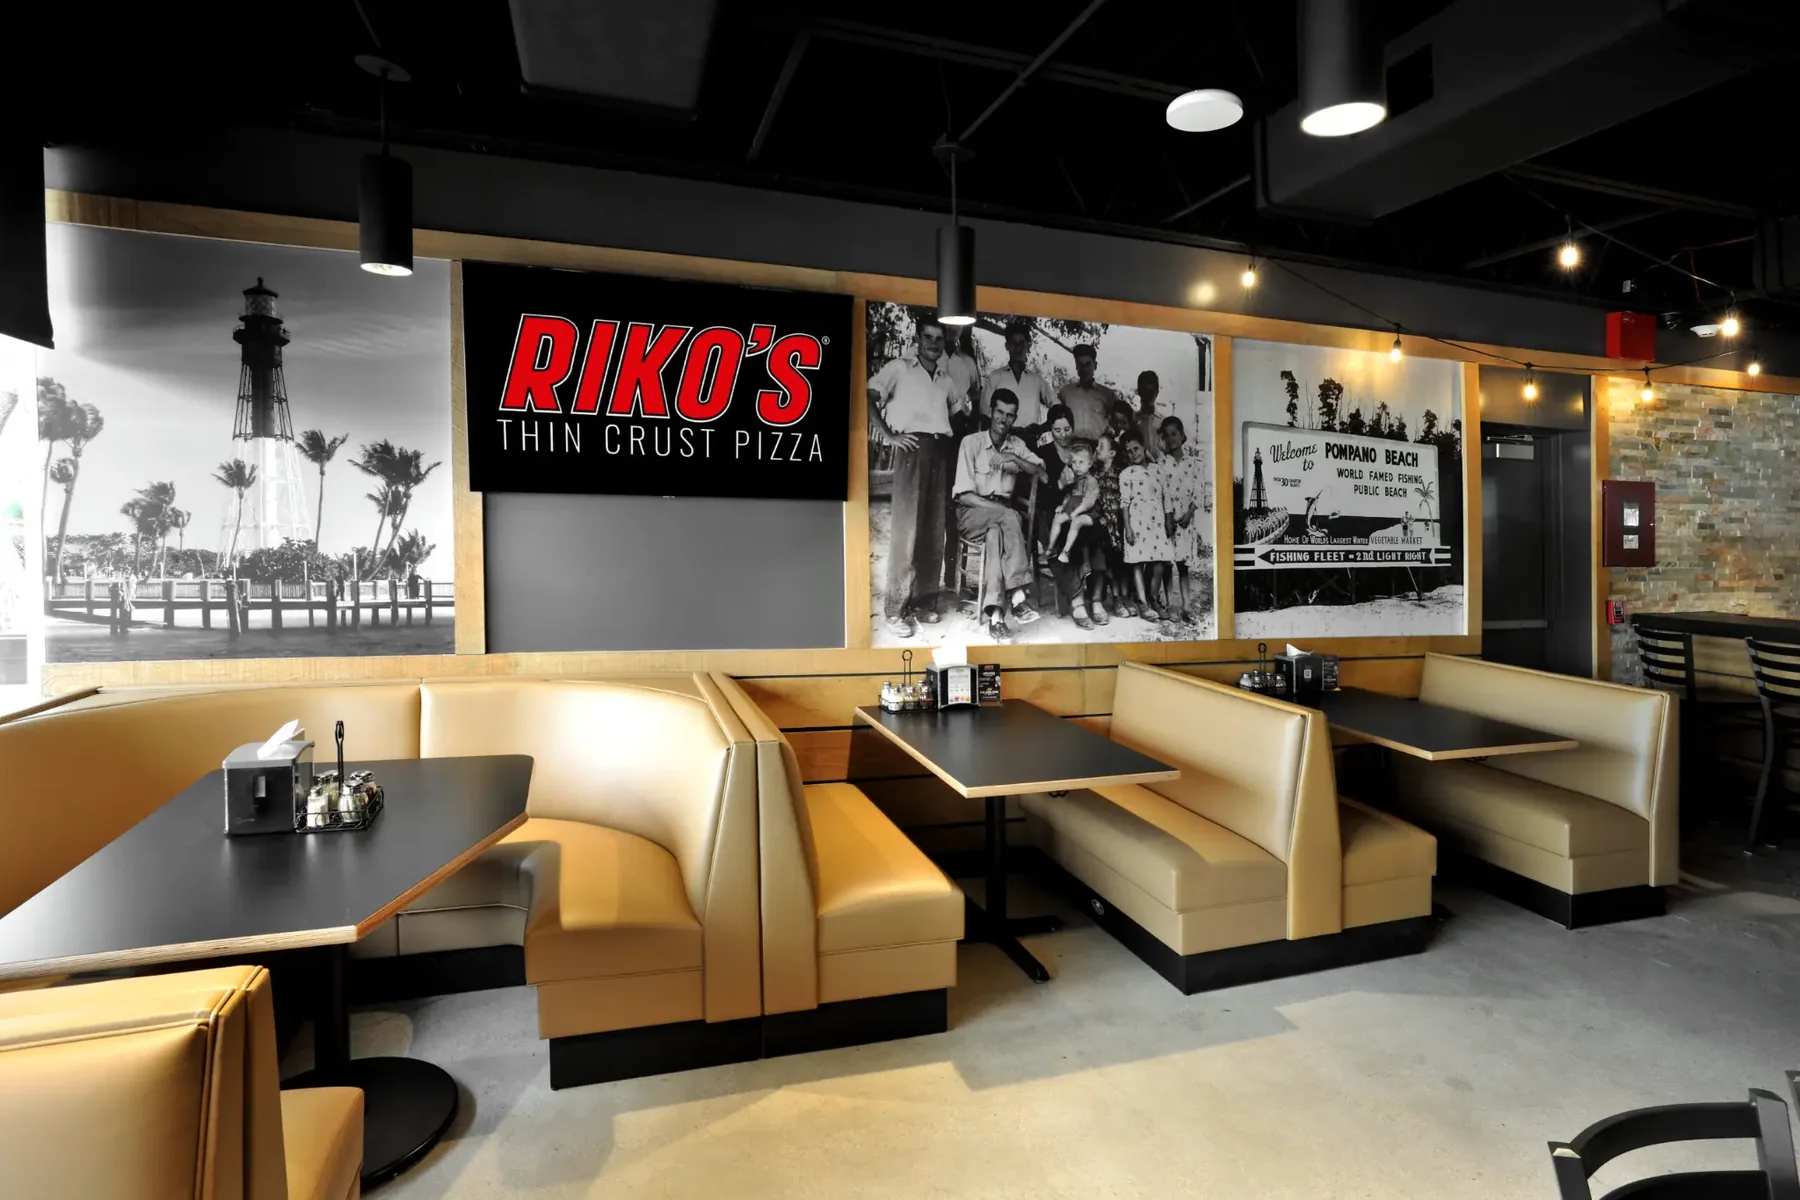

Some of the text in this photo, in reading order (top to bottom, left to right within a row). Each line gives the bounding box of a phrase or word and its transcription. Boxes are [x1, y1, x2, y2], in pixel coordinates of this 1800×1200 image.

[498, 313, 822, 427] RIKO'S
[497, 418, 823, 463] THIN CRUST PIZZA
[1269, 440, 1318, 464] Welcome
[1324, 441, 1419, 468] POMPANO BEACH
[1302, 458, 1315, 472] to
[1281, 477, 1289, 487] 30
[1336, 467, 1423, 485] WORLD FAMED FISHING
[1353, 484, 1408, 498] PUBLIC BEACH
[1371, 537, 1399, 545] VEGETABLE
[1401, 537, 1423, 545] MARKET
[1270, 551, 1310, 562] FISHING
[1313, 551, 1346, 562] FLEET
[1376, 551, 1402, 561] LIGHT
[1404, 551, 1427, 561] RIGHT
